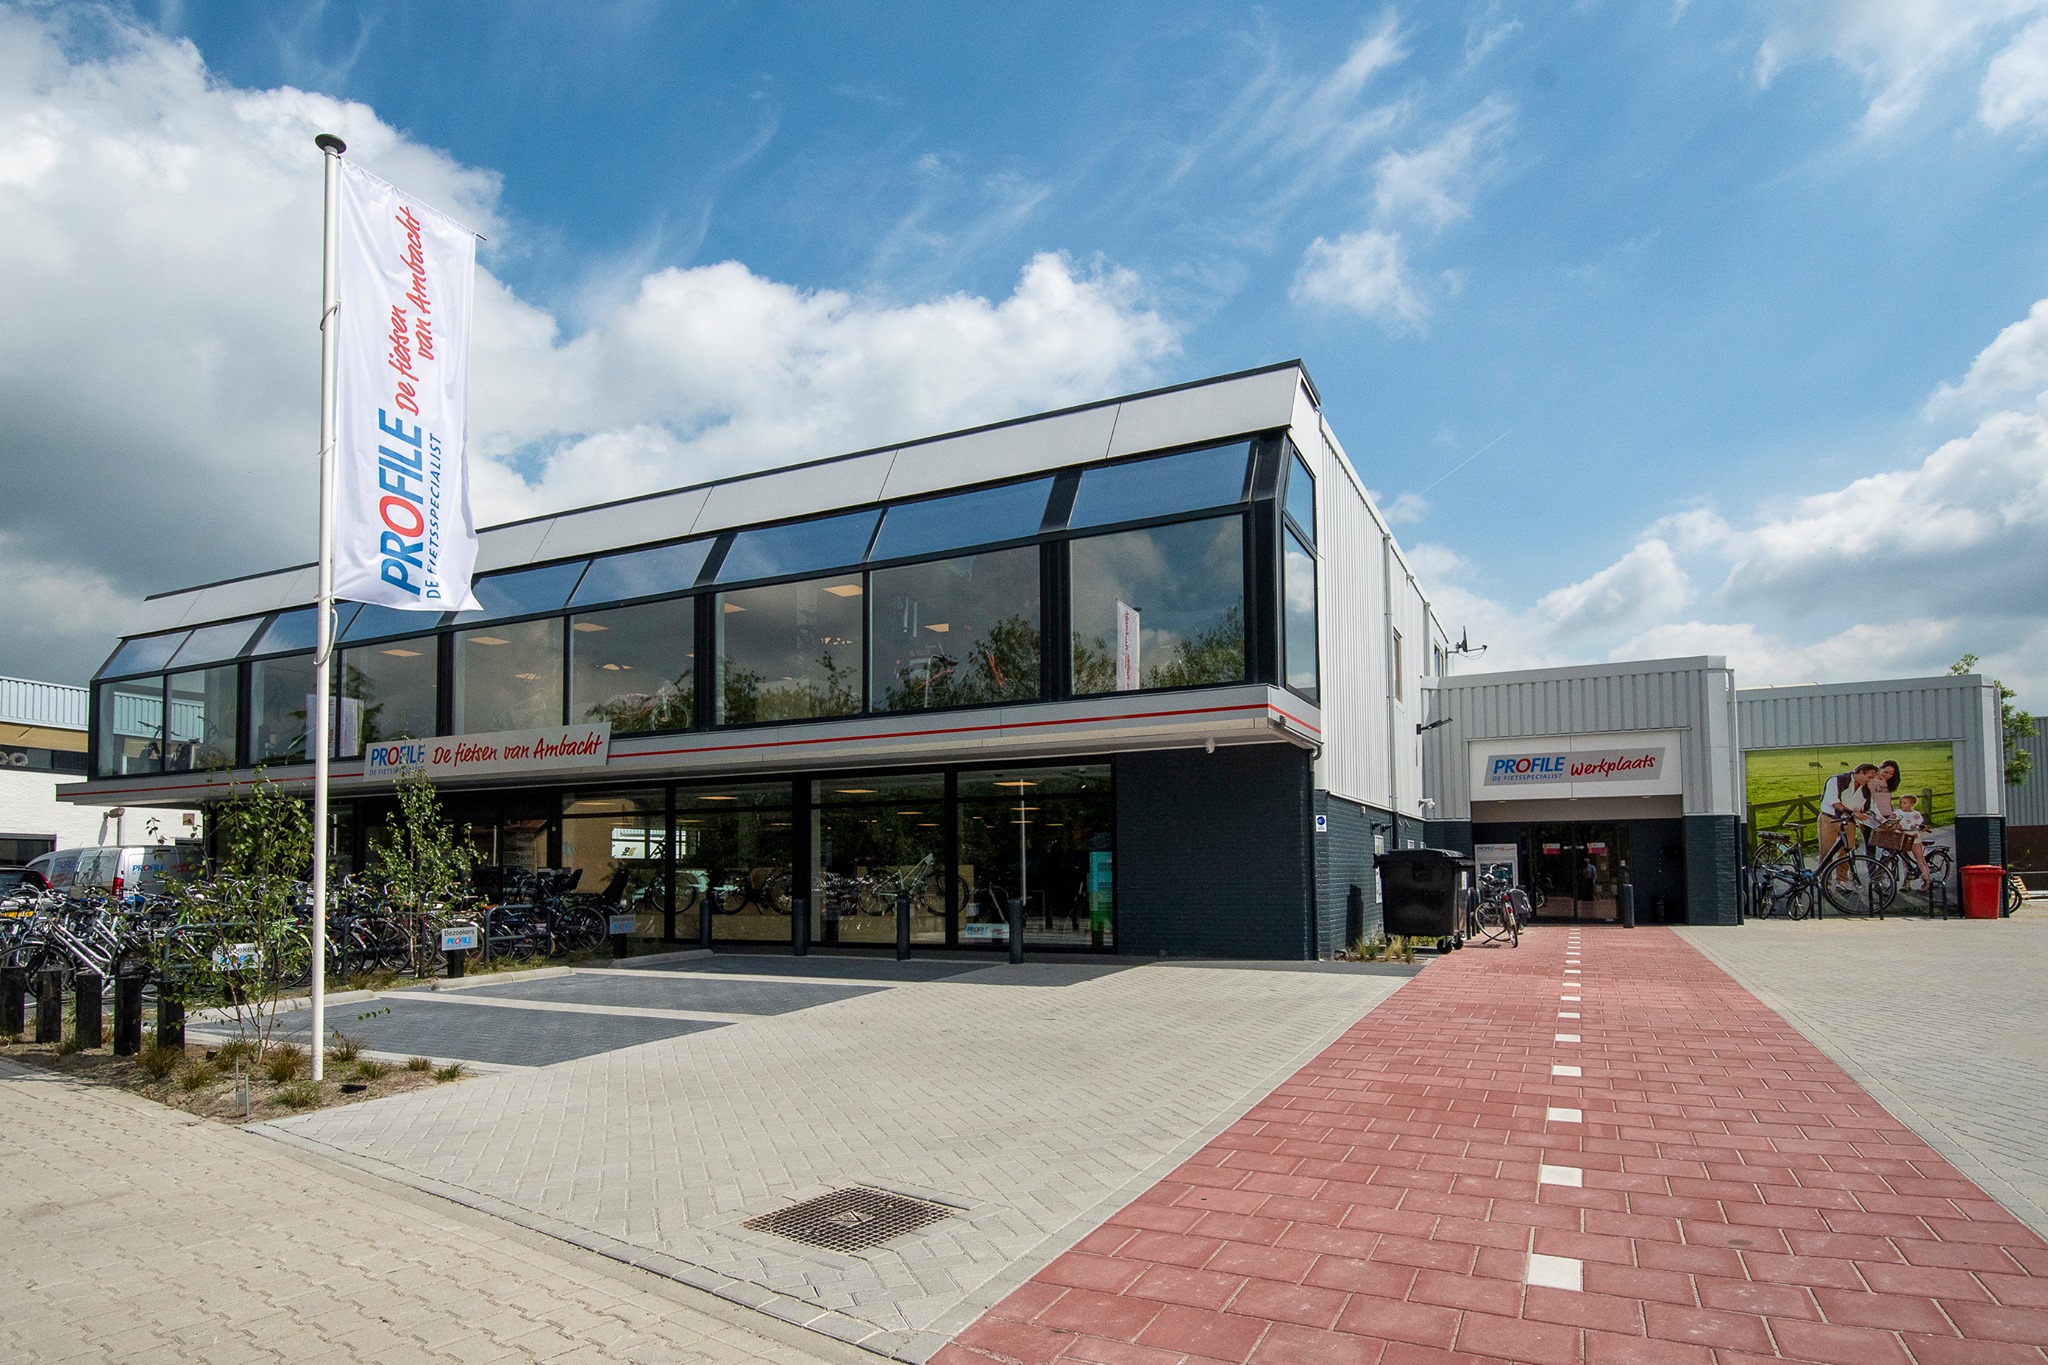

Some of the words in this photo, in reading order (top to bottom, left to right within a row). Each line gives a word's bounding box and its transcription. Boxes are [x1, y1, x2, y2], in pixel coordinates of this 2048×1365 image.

[395, 205, 431, 315] Ambacht
[389, 304, 420, 382] fietsen
[415, 317, 435, 361] van
[395, 380, 420, 416] De
[378, 407, 424, 596] PROFILE
[426, 432, 442, 576] FIETSSPECIALIST
[425, 579, 442, 600] DE
[370, 743, 426, 766] PROFILE
[432, 746, 453, 765] De
[454, 742, 497, 767] fietsen
[504, 743, 530, 760] van
[533, 731, 603, 760] Ambacht
[1493, 756, 1566, 774] PROFILE
[446, 936, 473, 945] PROFILE
